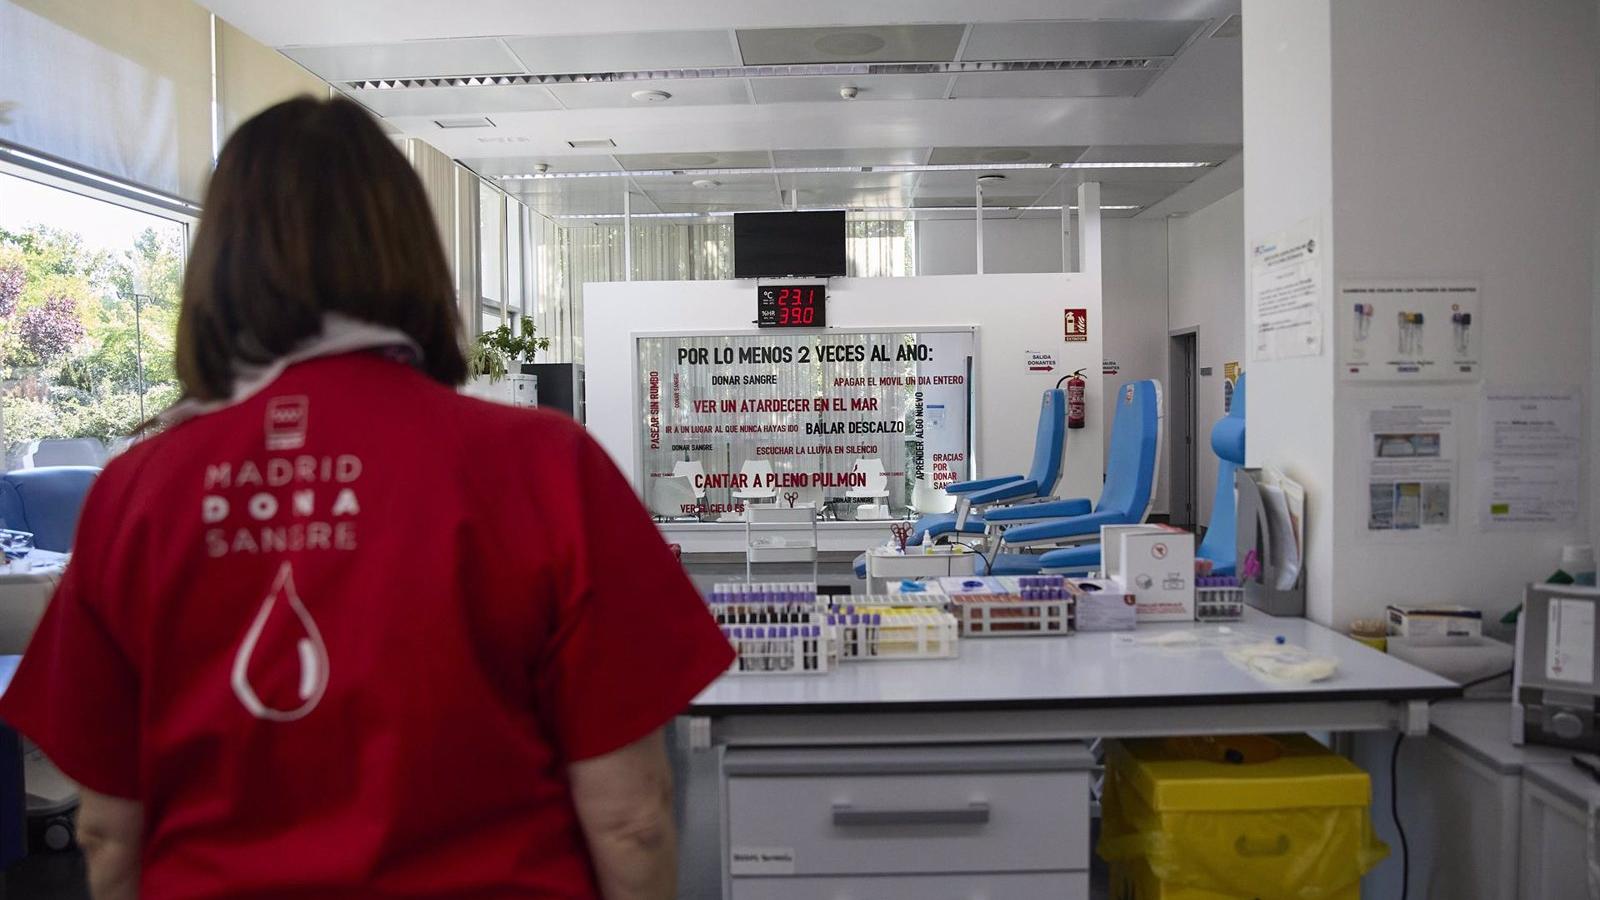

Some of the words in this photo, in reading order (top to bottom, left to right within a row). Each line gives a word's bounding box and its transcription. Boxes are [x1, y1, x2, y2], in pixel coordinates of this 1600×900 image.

[678, 348, 709, 365] POR
[714, 347, 734, 364] LO
[739, 346, 793, 364] MENOS
[798, 346, 811, 363] 2
[815, 345, 865, 363] VECES
[870, 345, 890, 362] AL
[650, 371, 659, 400] RUMBO
[712, 375, 741, 386] DONAR
[743, 374, 777, 385] SANGRE
[834, 377, 865, 387] APAGAR
[868, 377, 877, 386] EL
[905, 376, 916, 386] UN
[933, 375, 964, 385] ENTERO
[650, 402, 660, 415] SIN
[694, 400, 717, 414] VER
[720, 400, 737, 413] UN
[740, 399, 810, 413] ATARDECER
[814, 398, 829, 412] EN
[833, 398, 847, 412] EL
[851, 398, 878, 411] MAR
[915, 392, 924, 417] NUEVO
[650, 417, 660, 450] PASEAR
[666, 425, 673, 434] IR
[674, 425, 680, 434] A
[680, 425, 689, 434] UN
[691, 425, 713, 434] LUGAR
[715, 425, 724, 433] AL
[725, 425, 738, 433] QUE
[740, 425, 762, 433] NUNCA
[763, 424, 786, 433] HAYAS
[787, 424, 799, 432] IDO
[806, 421, 846, 435] BAILAR
[850, 420, 904, 434] DESCALZO
[915, 419, 924, 438] ALGO
[756, 446, 794, 455] ESCUCHAR
[796, 446, 806, 455] LA
[807, 446, 833, 455] LLUVIA
[834, 445, 845, 454] EN
[846, 445, 878, 454] SILENCIO
[932, 453, 964, 462] GRACIAS
[916, 441, 924, 480] APRENDER
[933, 463, 948, 471] POR
[204, 454, 363, 490] MADRID
[694, 474, 748, 489] CANTAR
[753, 473, 763, 488] A
[766, 473, 808, 488] PLENO
[812, 464, 867, 488] PULMÓN
[933, 472, 957, 481] DONAR
[202, 488, 361, 525] DONA
[680, 504, 698, 514] VER
[710, 503, 732, 513] CIELO
[205, 521, 358, 558] SANGRE
